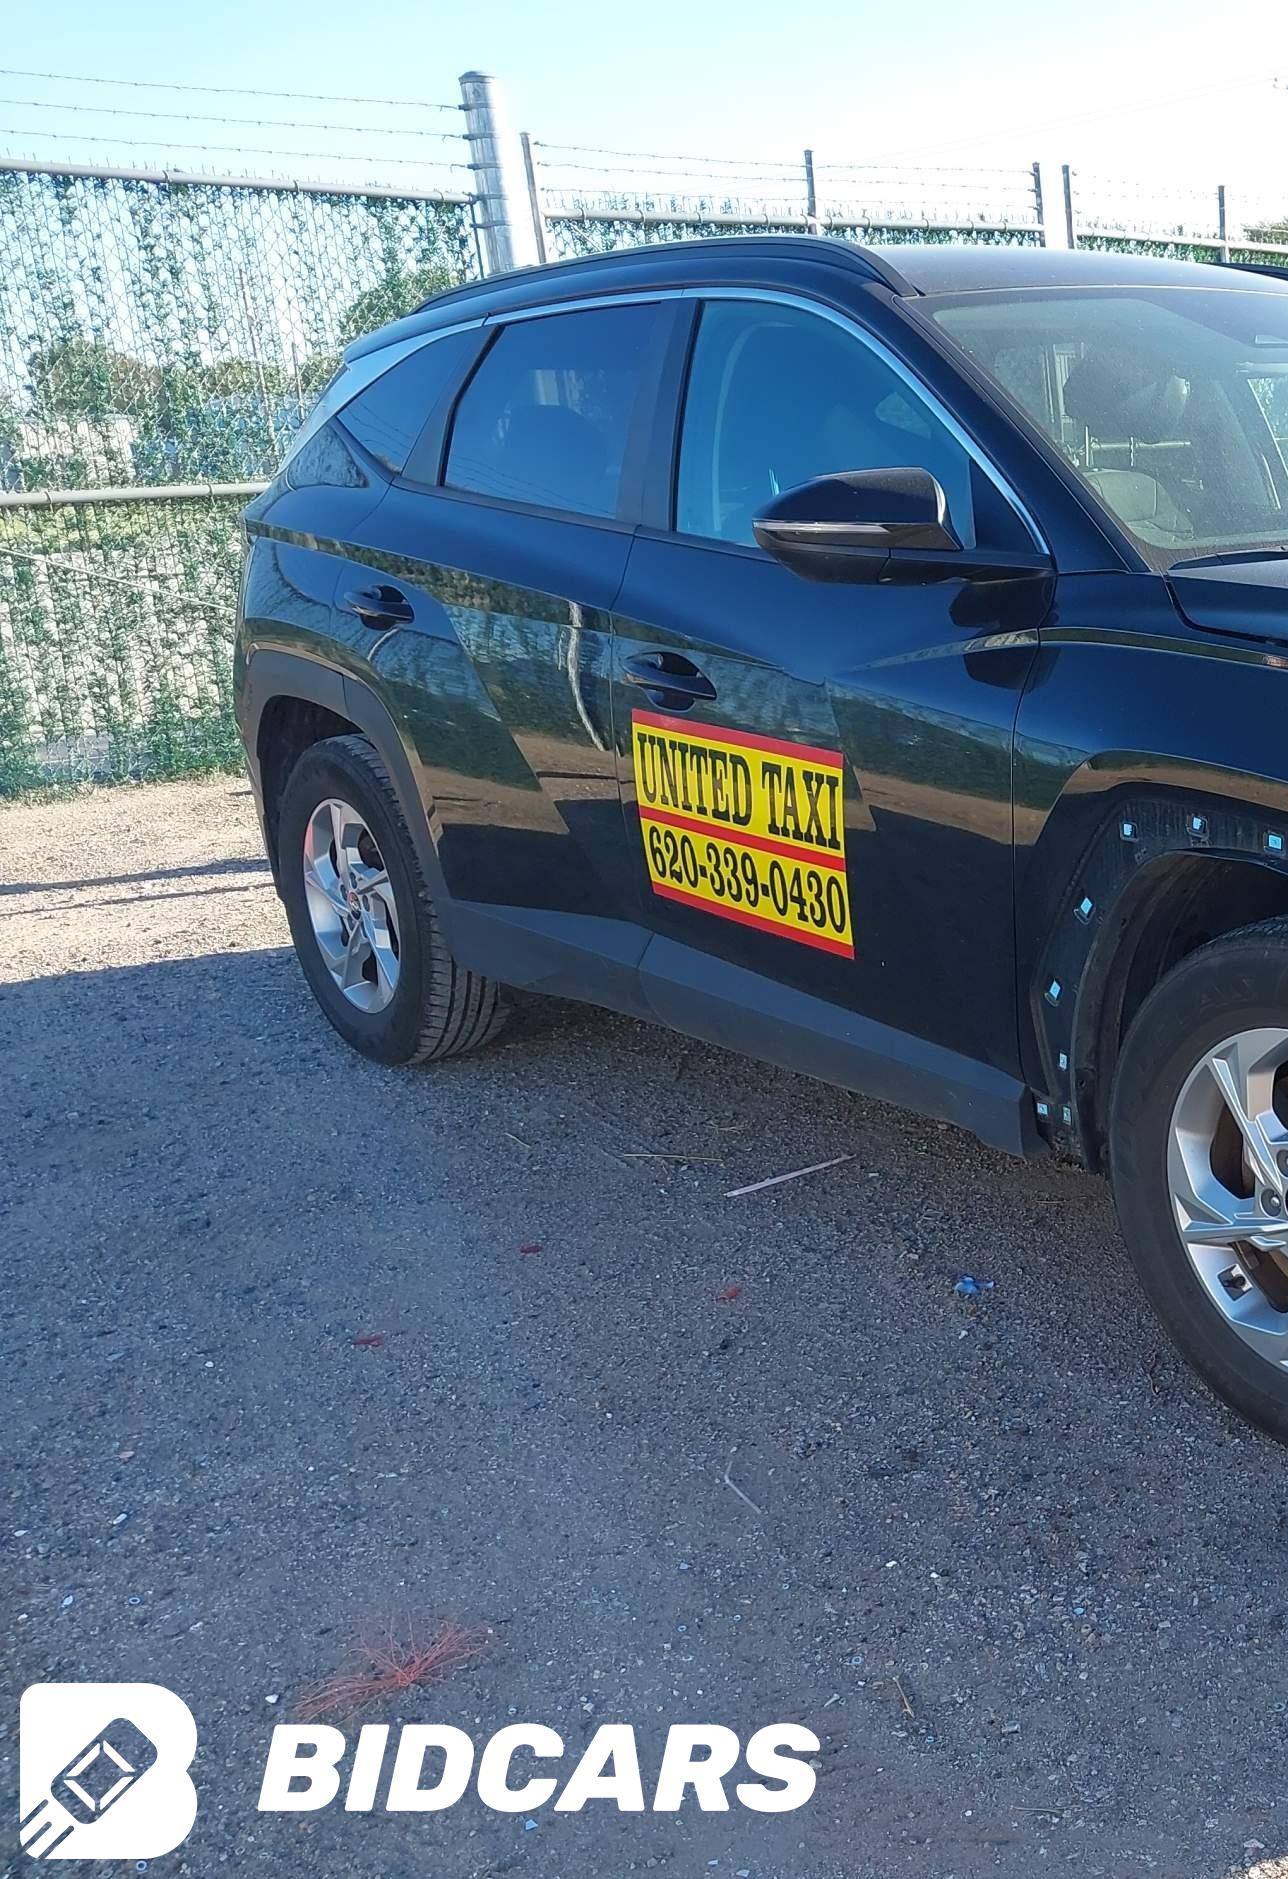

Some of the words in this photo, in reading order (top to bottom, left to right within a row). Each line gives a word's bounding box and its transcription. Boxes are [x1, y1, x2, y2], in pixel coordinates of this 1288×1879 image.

[637, 733, 752, 826] UNITED
[761, 761, 841, 850] TAXI
[649, 825, 846, 934] 620-339-0430
